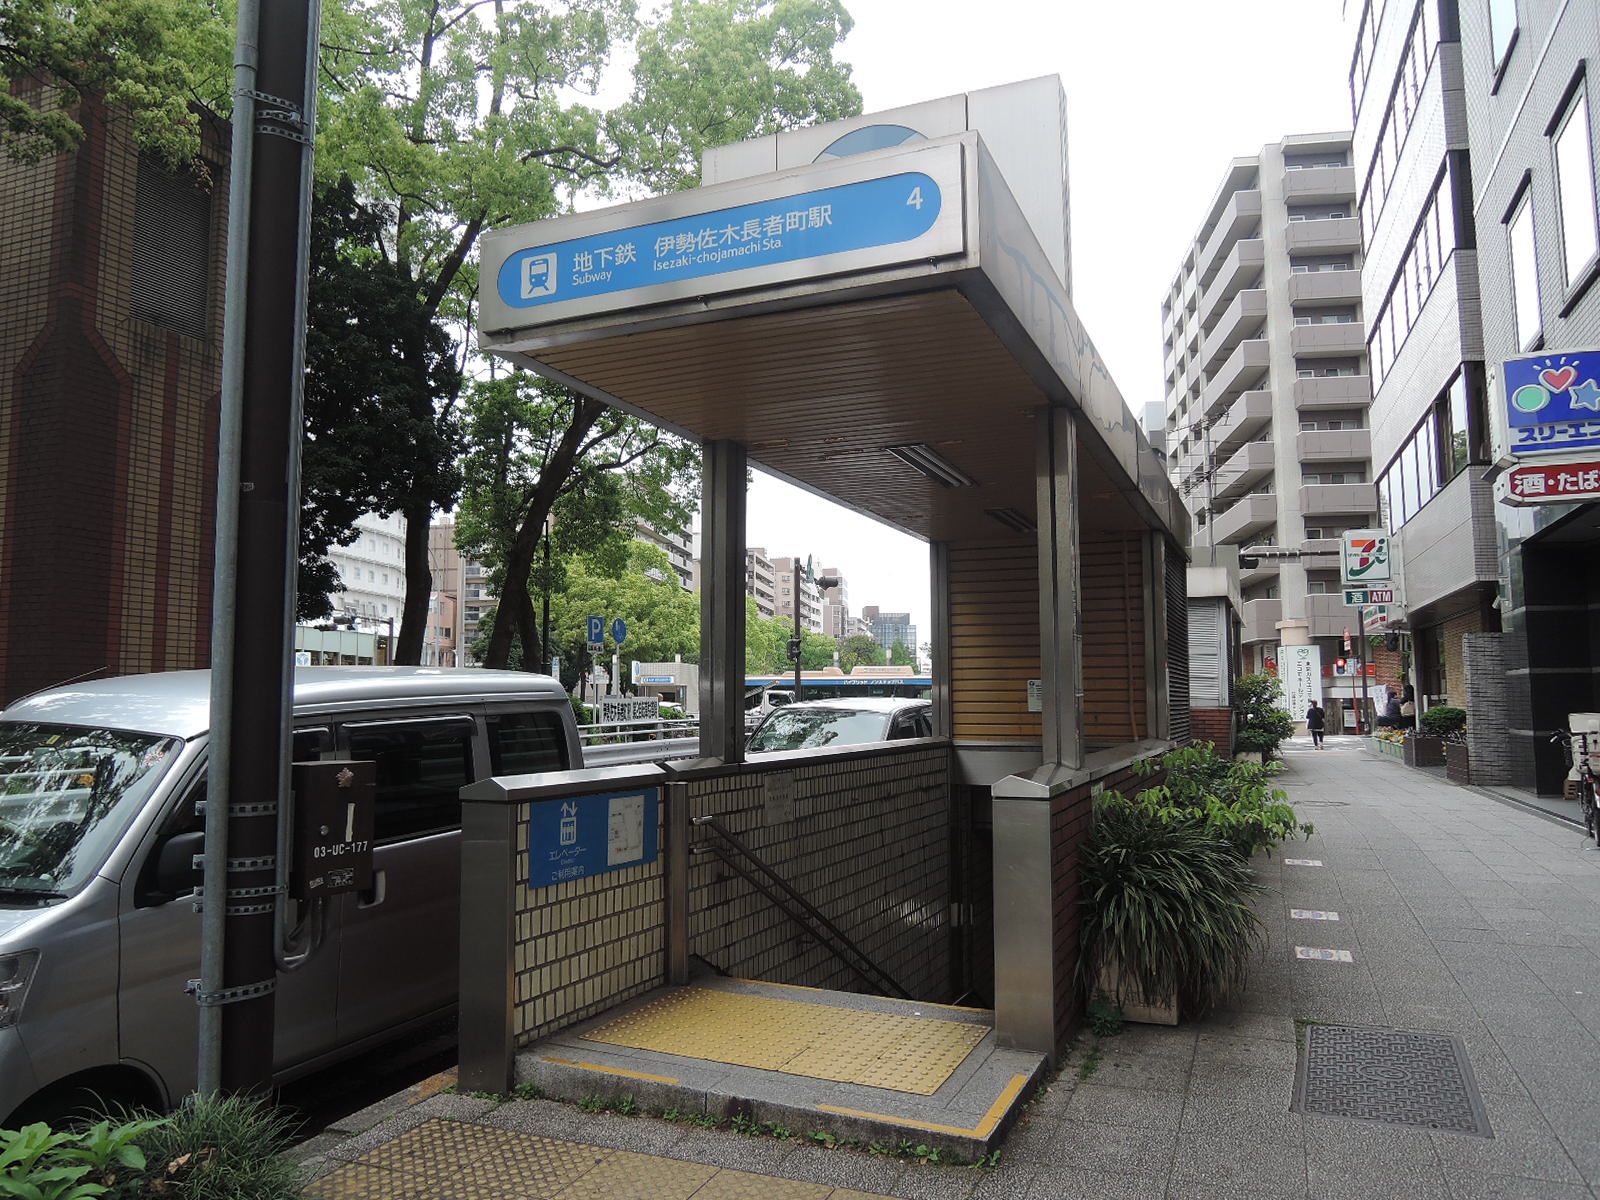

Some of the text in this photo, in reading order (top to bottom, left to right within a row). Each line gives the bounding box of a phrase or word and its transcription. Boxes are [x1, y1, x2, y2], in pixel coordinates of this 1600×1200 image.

[906, 187, 924, 210] 4
[572, 204, 833, 272] 地下鉄 伊勢佐木長者町駅
[653, 239, 784, 272] Isezaki-chojamachi Sta.
[572, 269, 612, 286] Subway
[1513, 469, 1600, 495] 酒・たば
[1351, 591, 1391, 604] 酒 ATM
[591, 618, 601, 640] P
[313, 840, 369, 858] 03-UC-177
